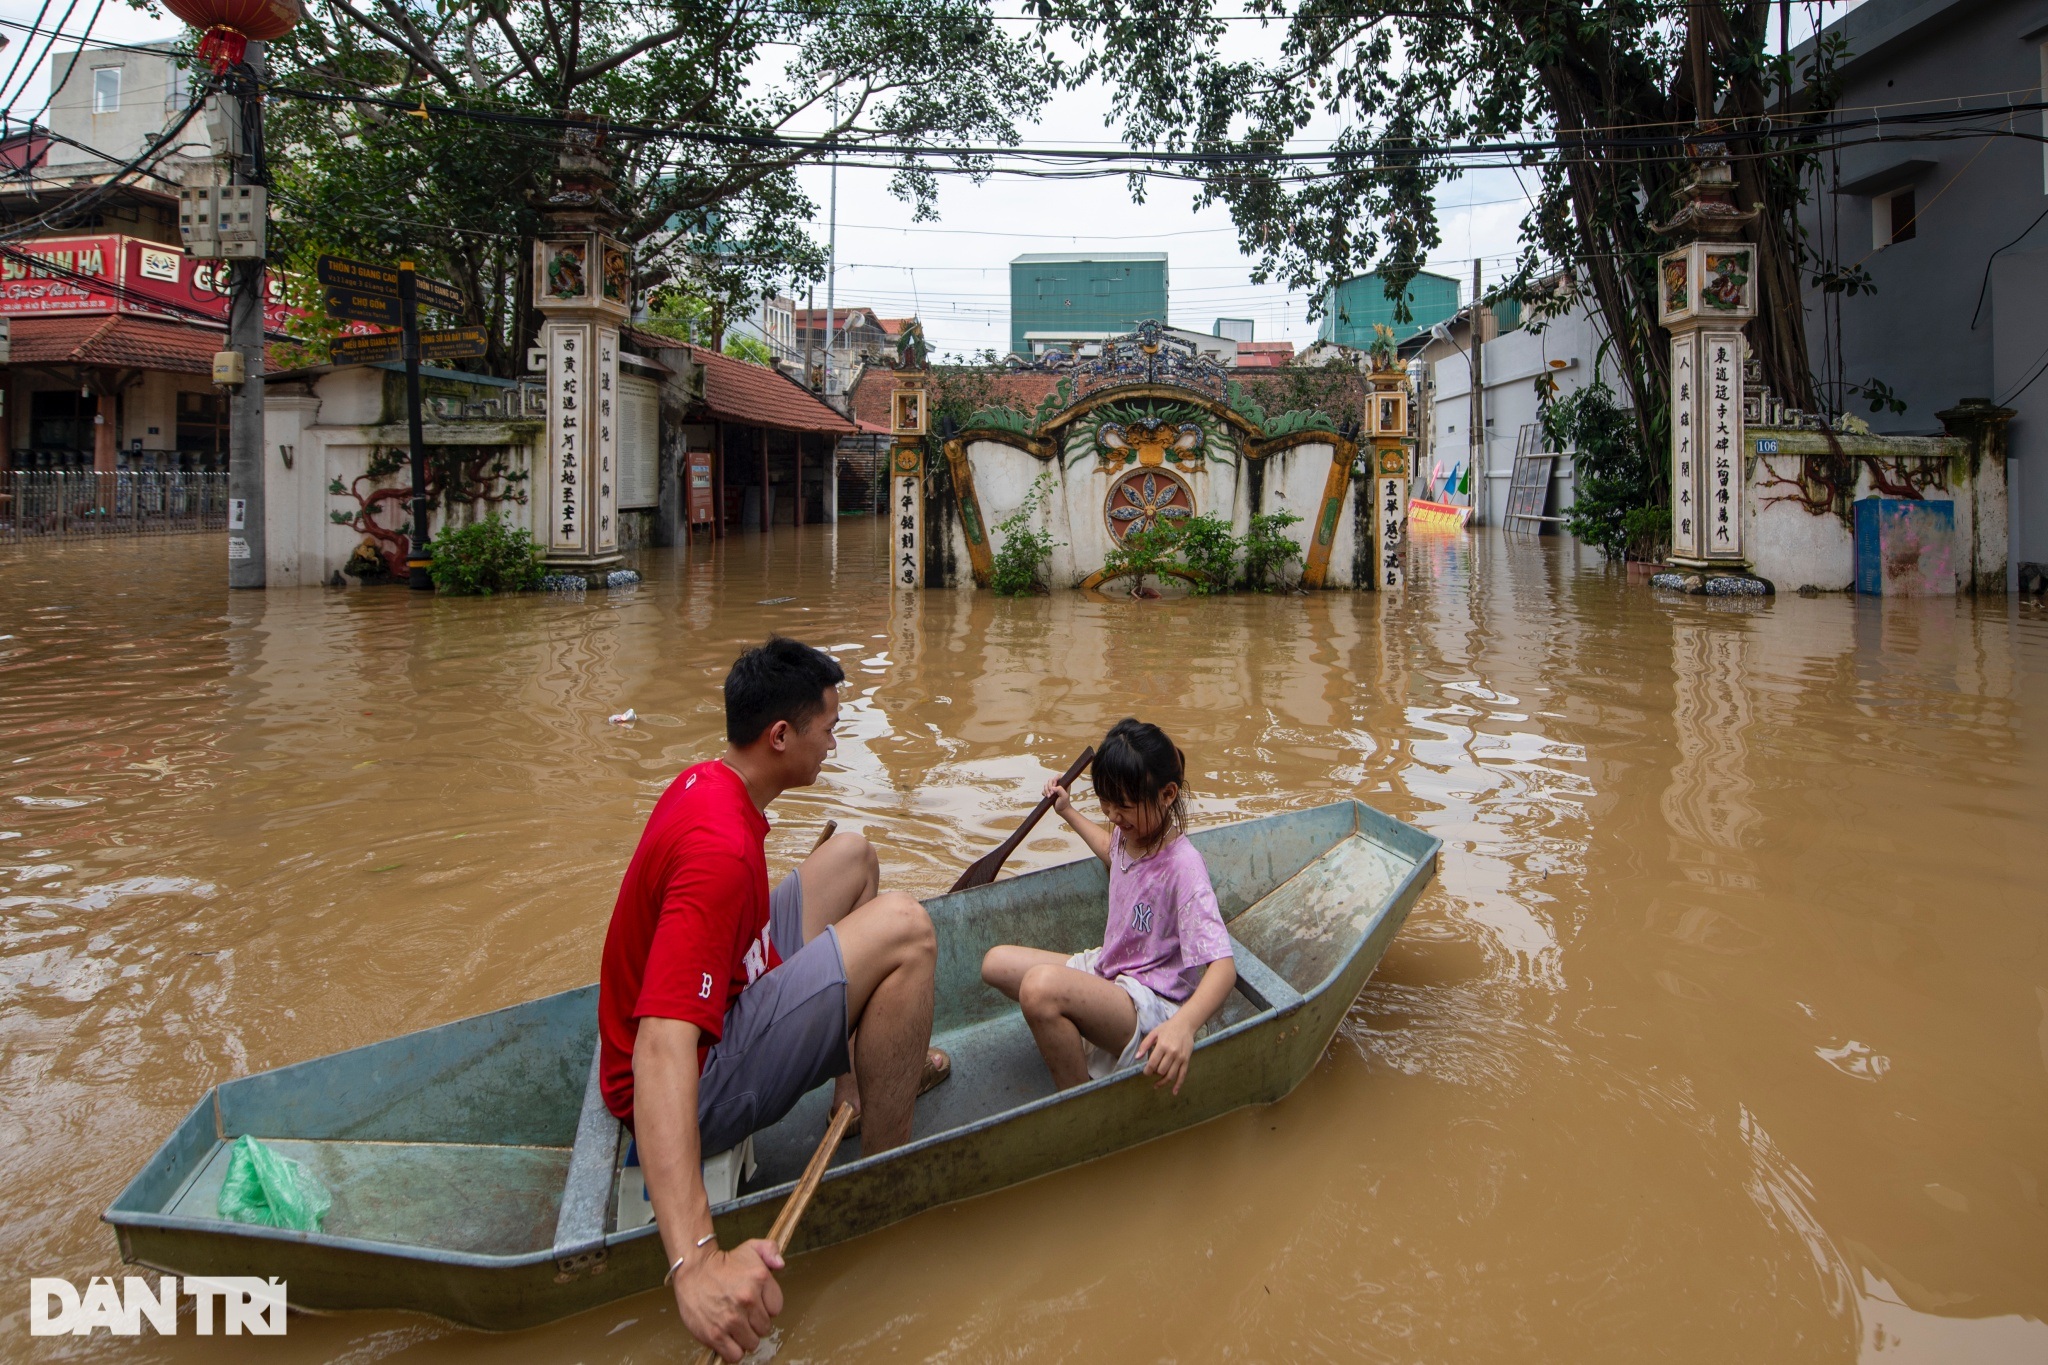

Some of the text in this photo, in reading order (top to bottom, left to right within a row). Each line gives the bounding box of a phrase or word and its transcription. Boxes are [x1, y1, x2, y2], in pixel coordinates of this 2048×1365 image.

[30, 251, 73, 278] NAM
[78, 243, 105, 276] HÀ
[328, 260, 396, 283] THÔN 3 GIANG CAO
[328, 275, 356, 286] Village
[364, 282, 384, 292] Giang
[416, 279, 458, 300] THÔN 1 GIANG CAO
[370, 297, 386, 310] GỐM
[370, 338, 386, 346] GIANG
[388, 337, 398, 345] CAO
[1759, 441, 1776, 451] 106
[1132, 902, 1154, 933] NY
[698, 972, 713, 998] B
